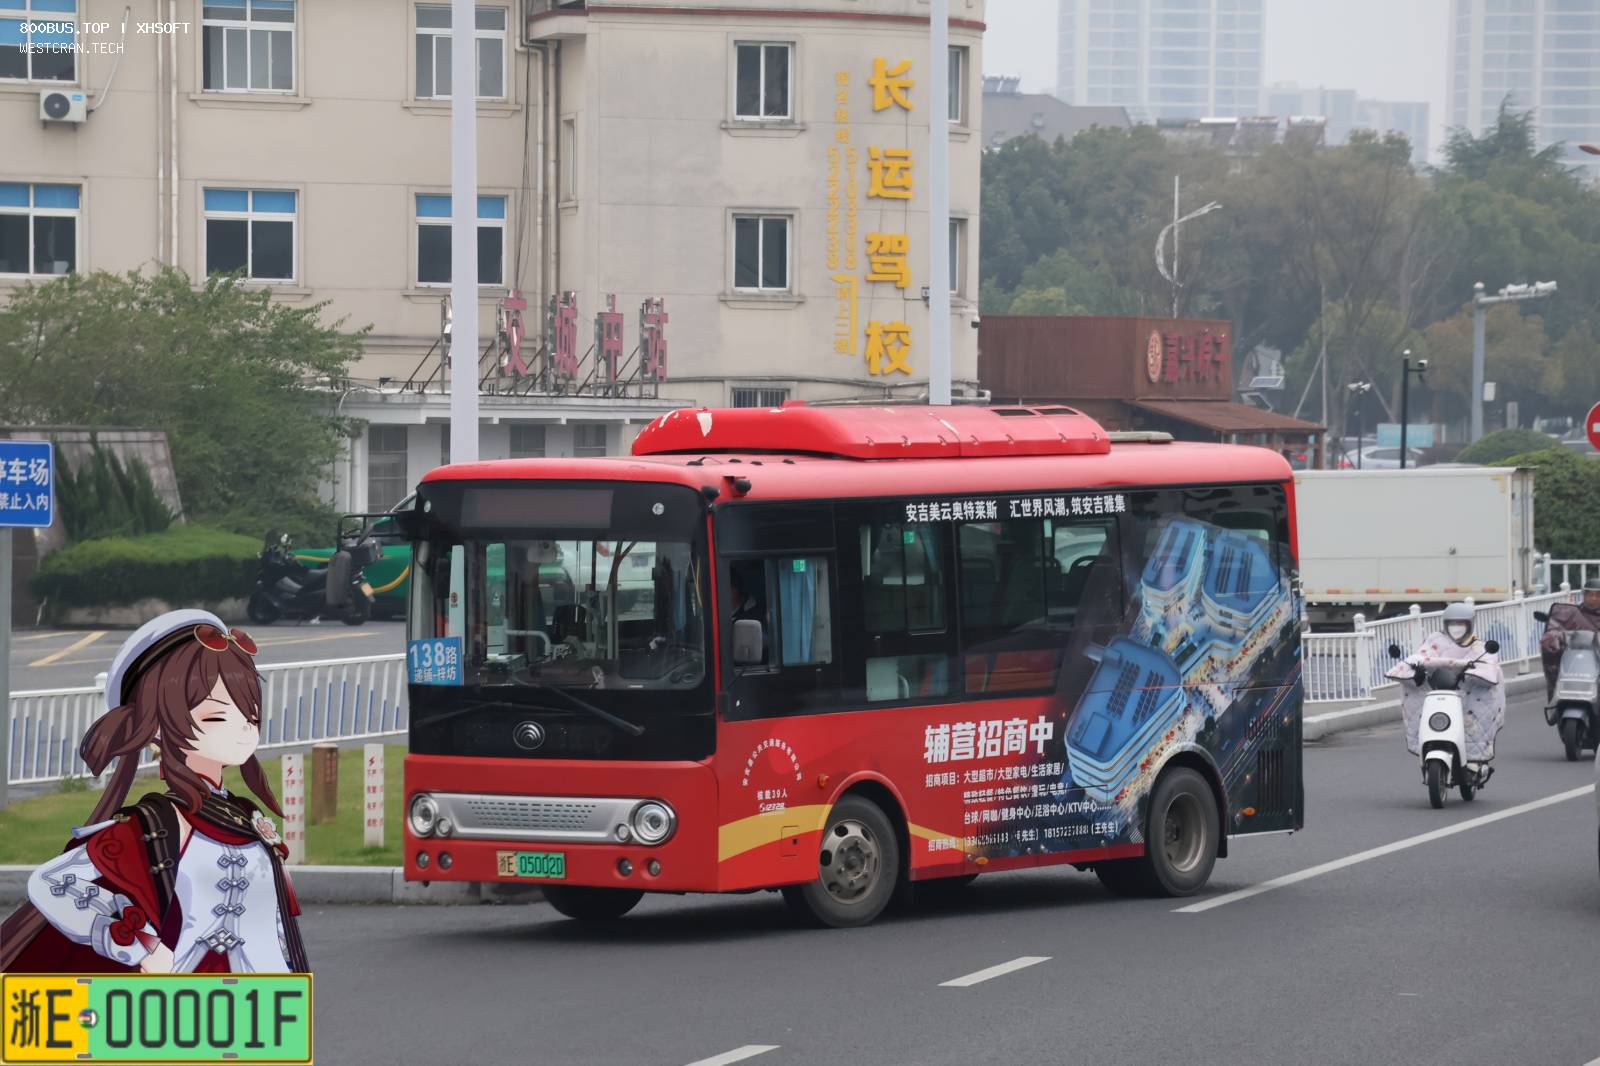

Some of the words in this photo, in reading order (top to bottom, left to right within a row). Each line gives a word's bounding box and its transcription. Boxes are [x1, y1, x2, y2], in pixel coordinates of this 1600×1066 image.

[865, 57, 915, 375] 长运驾校
[906, 500, 997, 522] 安吉美云奥特莱斯
[410, 641, 457, 668] 138路
[924, 715, 1054, 764] 辅营招商中
